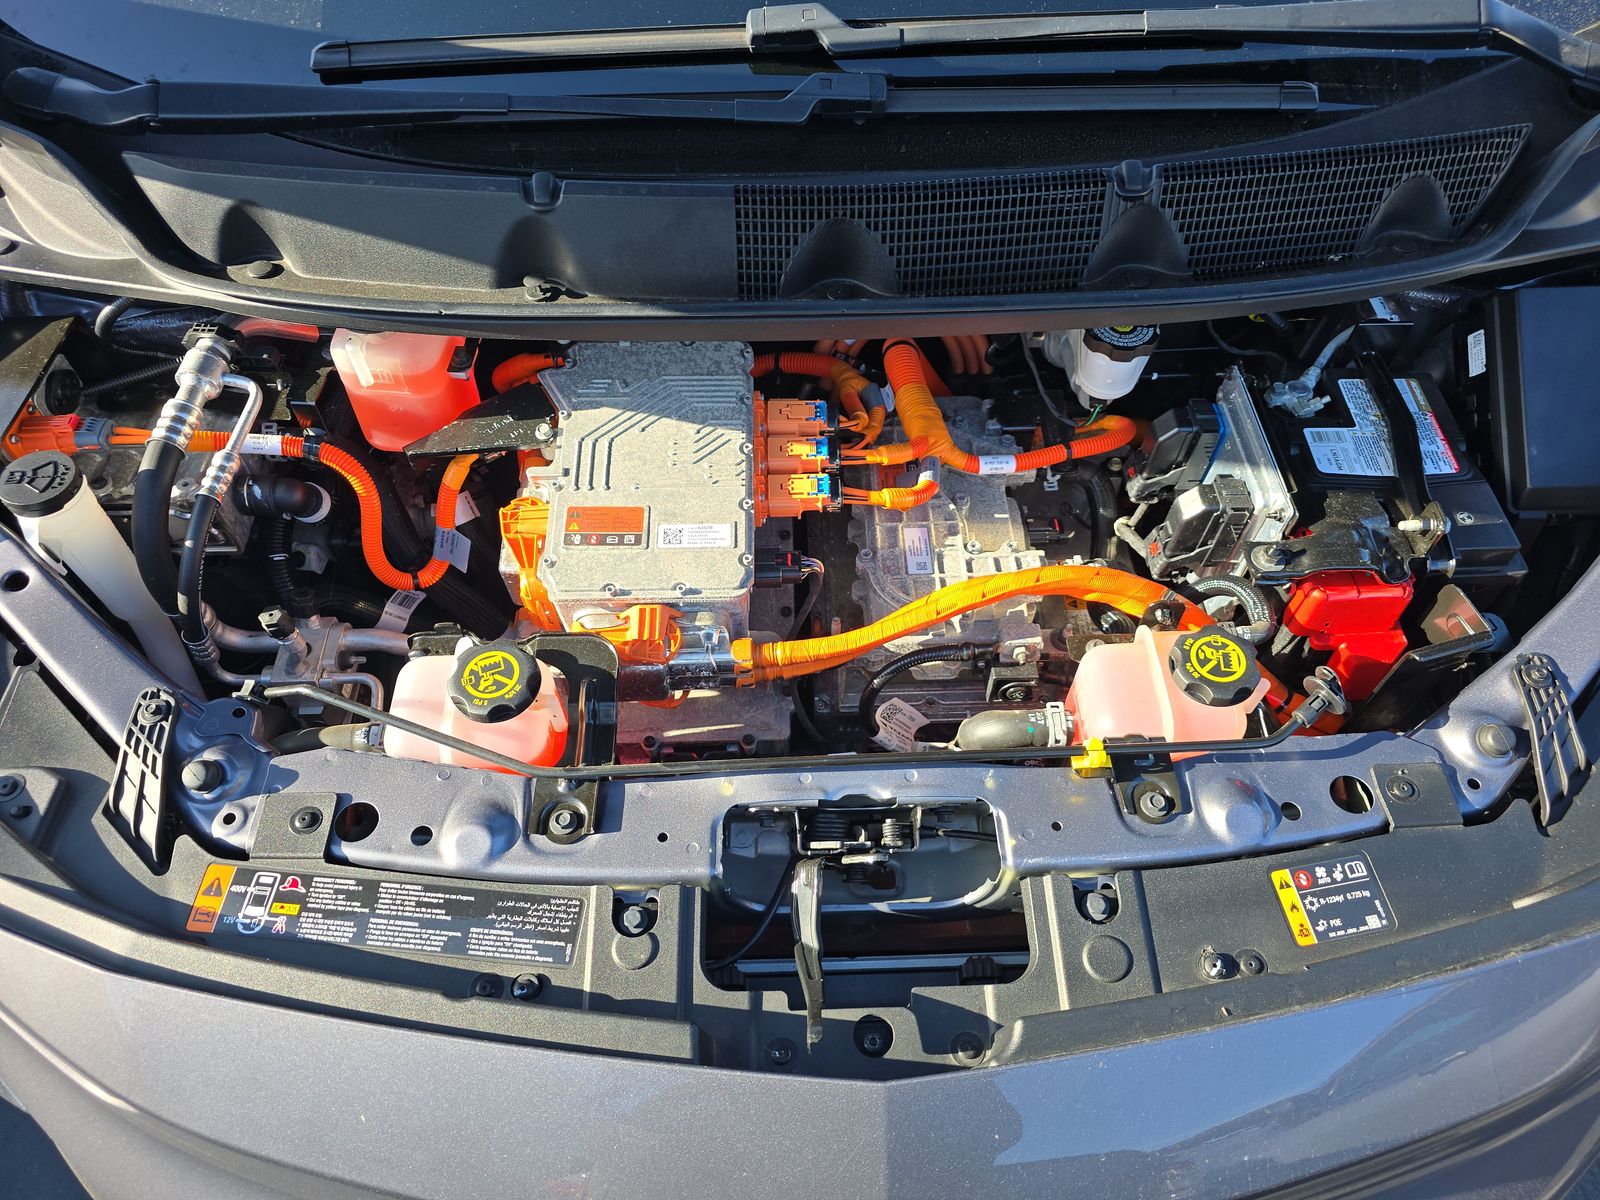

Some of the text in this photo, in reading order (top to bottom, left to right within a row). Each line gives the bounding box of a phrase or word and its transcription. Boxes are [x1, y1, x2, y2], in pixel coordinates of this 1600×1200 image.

[1318, 876, 1331, 885] AUTO
[230, 885, 247, 893] 400V
[1320, 890, 1370, 906] R-1234yf 0.725 kg
[223, 916, 236, 924] 12V
[1330, 918, 1342, 927] POE
